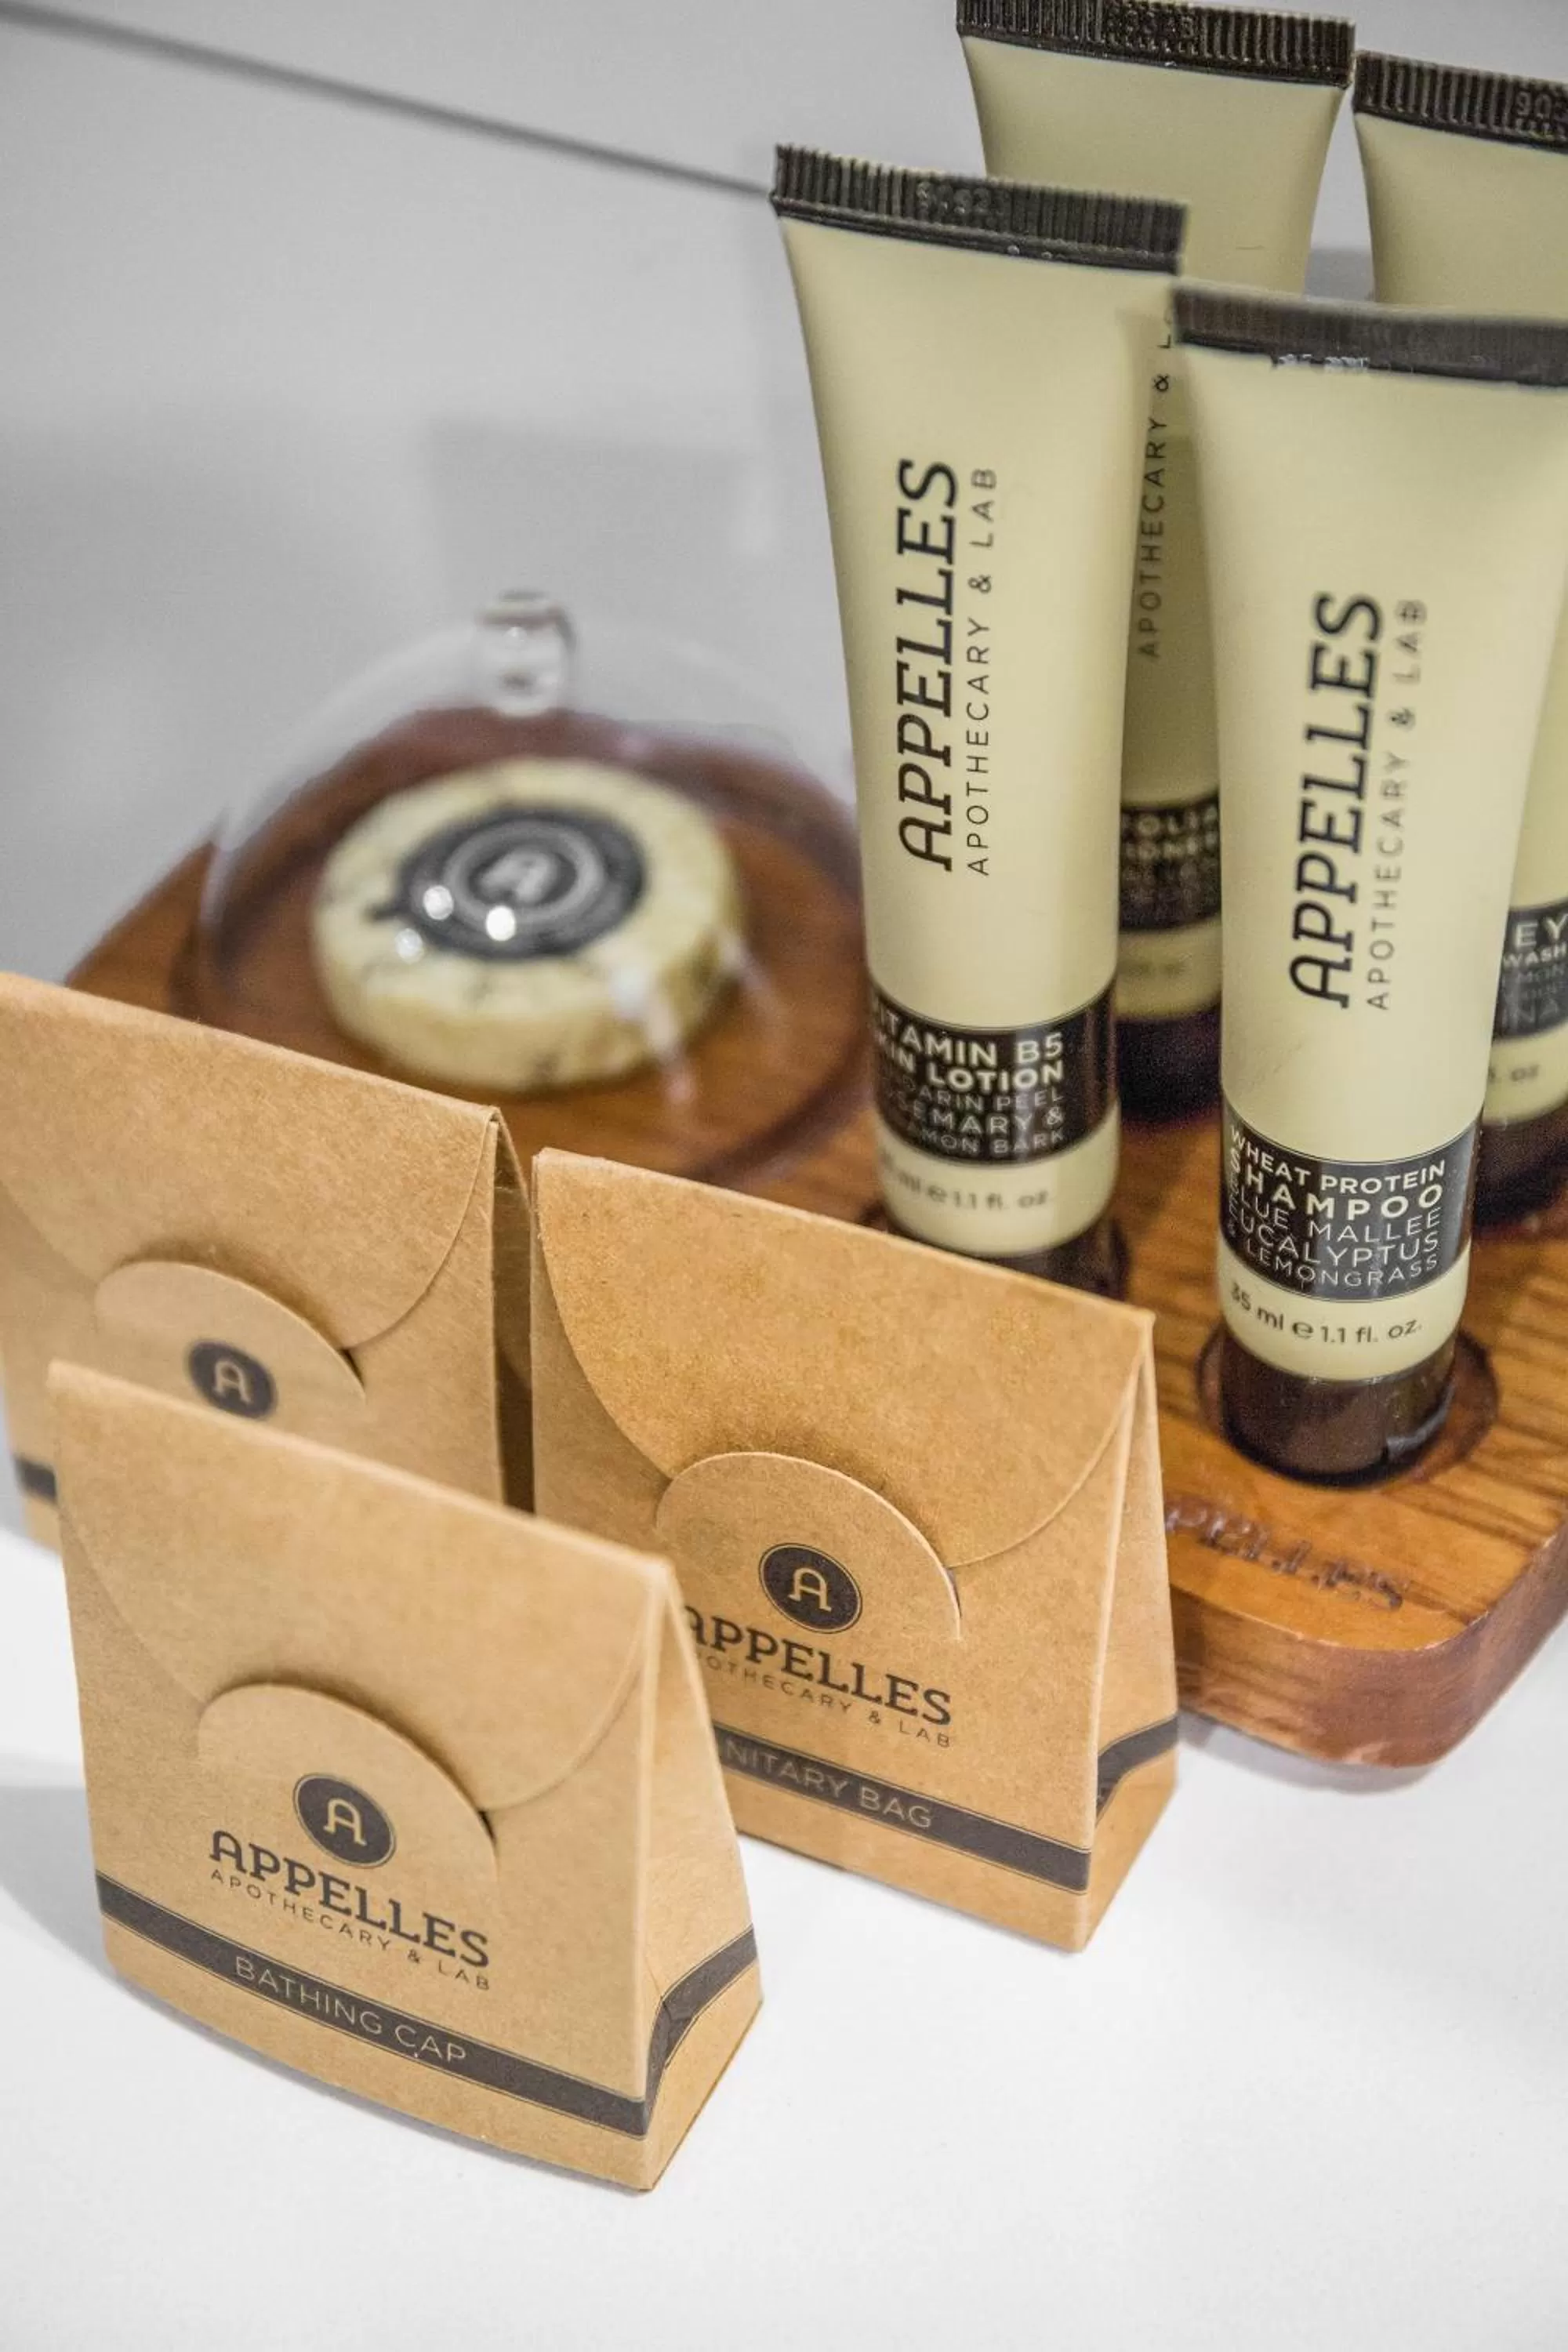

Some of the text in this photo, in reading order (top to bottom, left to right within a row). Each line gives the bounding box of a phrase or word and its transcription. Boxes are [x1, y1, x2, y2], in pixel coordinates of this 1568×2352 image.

[1152, 373, 1170, 392] &
[1138, 418, 1167, 659] APOTHECARY
[895, 459, 958, 872] APPELLES
[965, 468, 996, 876] APOTHECARY & LAB
[1288, 592, 1385, 1009] APPELLES
[1367, 599, 1427, 1010] APOTHECARY & LAB
[1514, 912, 1568, 949] EY
[874, 999, 1065, 1069] ITAMIN B5
[926, 1059, 1065, 1093] LOTION
[996, 1087, 1064, 1112] PEEL
[1230, 1147, 1443, 1221] SHAMPOO
[1231, 1125, 1446, 1195] WHEAT PROTEIN
[1308, 1207, 1441, 1243] MALLEE
[1247, 1238, 1439, 1288] LEMONGRASS
[1257, 1306, 1284, 1330] ml
[1319, 1324, 1347, 1344] 1.1
[212, 1359, 253, 1404] A
[787, 1566, 833, 1613] A
[685, 1605, 952, 1726] APPELLES
[701, 1654, 951, 1748] OTHECARY & LAB
[724, 1738, 933, 1829] NITARY BAG
[323, 1797, 368, 1847] A
[209, 1830, 490, 1969] APPELLES
[210, 1868, 492, 1991] APOTHECARY & LAB
[235, 1955, 467, 2064] BATHING CAP
